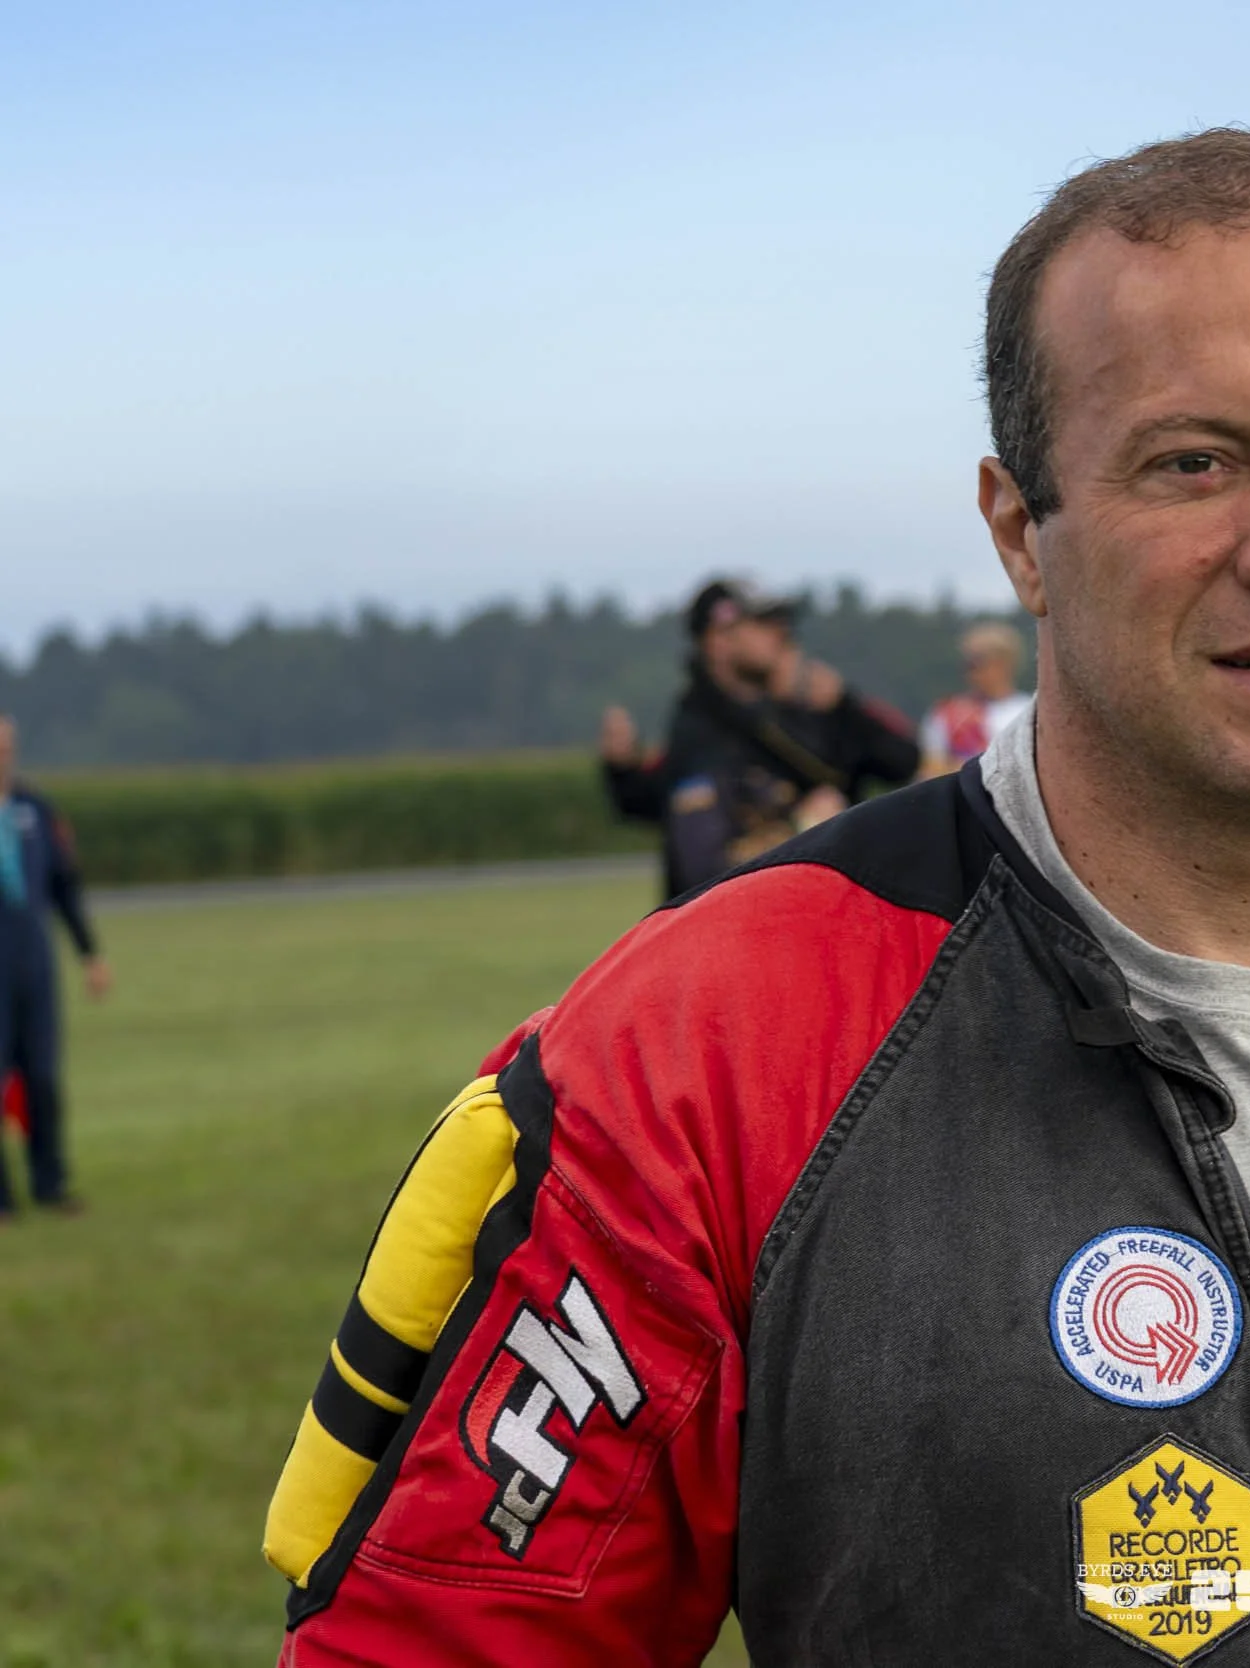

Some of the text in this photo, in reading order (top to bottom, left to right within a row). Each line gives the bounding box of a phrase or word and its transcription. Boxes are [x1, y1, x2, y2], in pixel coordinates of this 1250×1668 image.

[1064, 1238, 1229, 1373] ACCELERATED FREEFALL INSTRUCTOR
[1094, 1360, 1144, 1393] USPA
[1109, 1527, 1239, 1558] RECORDE
[1148, 1609, 1213, 1637] 2019
